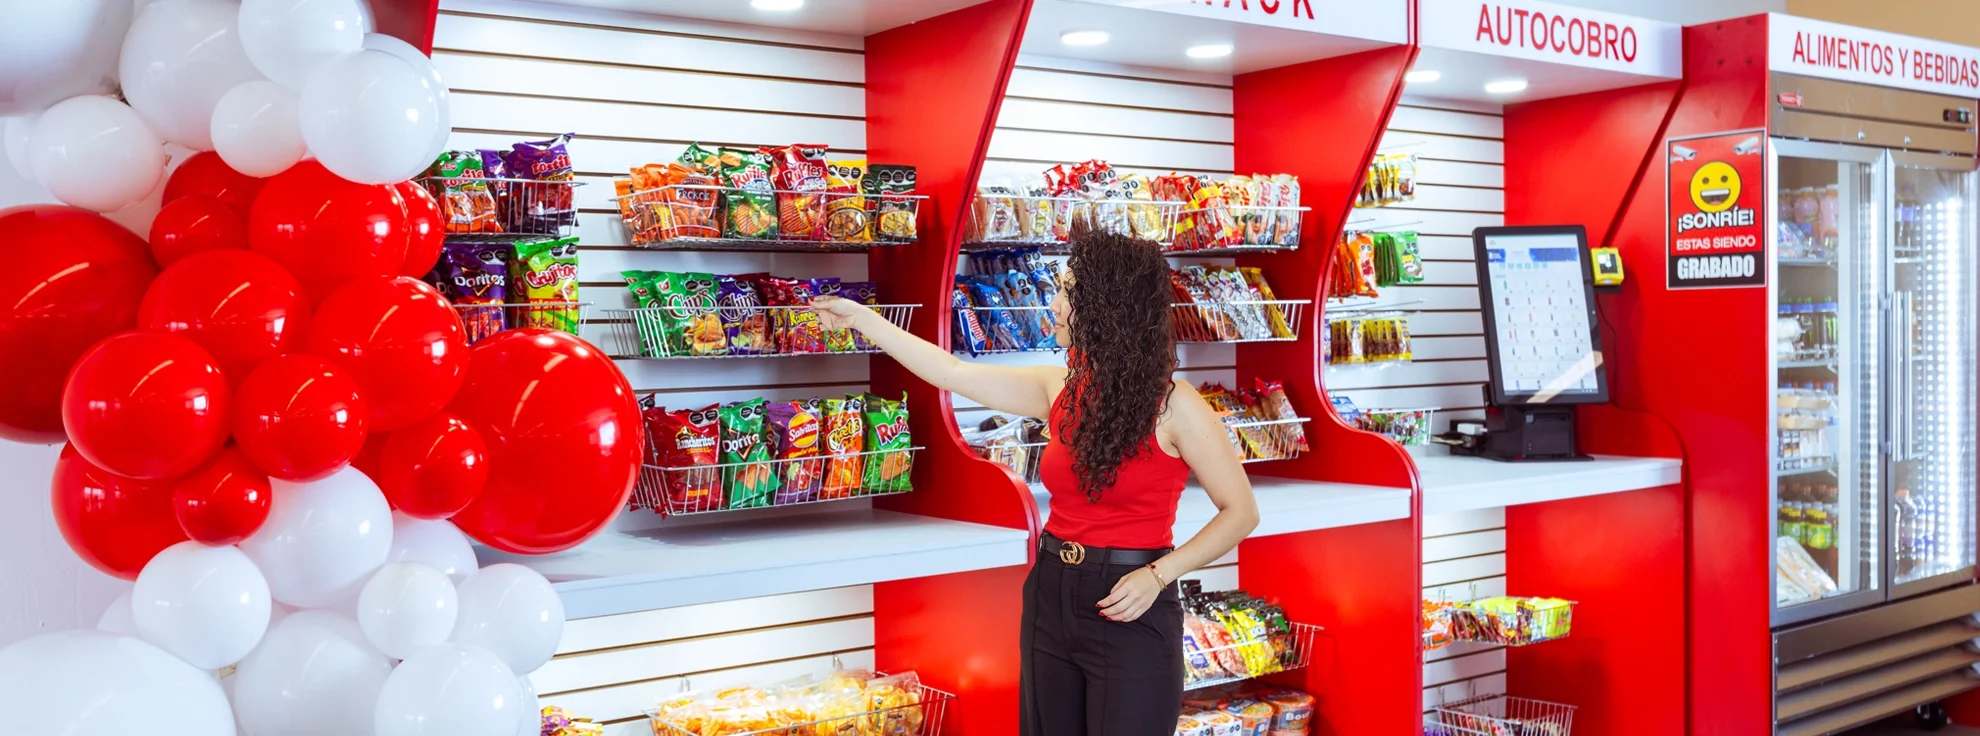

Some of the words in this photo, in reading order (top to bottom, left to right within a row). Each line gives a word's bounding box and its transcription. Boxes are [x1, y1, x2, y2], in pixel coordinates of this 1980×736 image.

[1476, 3, 1637, 63] AUTOCOBRO
[1793, 31, 1894, 76] ALIMENTOS
[1898, 47, 1908, 78] Y
[1913, 50, 1979, 89] BEBIDAS
[782, 160, 823, 190] Ruffles
[1677, 206, 1755, 233] ¡SONRÍE!
[1676, 237, 1711, 251] ESTAS
[1712, 234, 1756, 249] SIENDO
[454, 272, 505, 288] Doritos
[526, 263, 577, 288] Crujitos
[1676, 254, 1756, 280] GRABADO
[676, 433, 717, 451] Rancheritos
[828, 418, 862, 452] Cheetos
